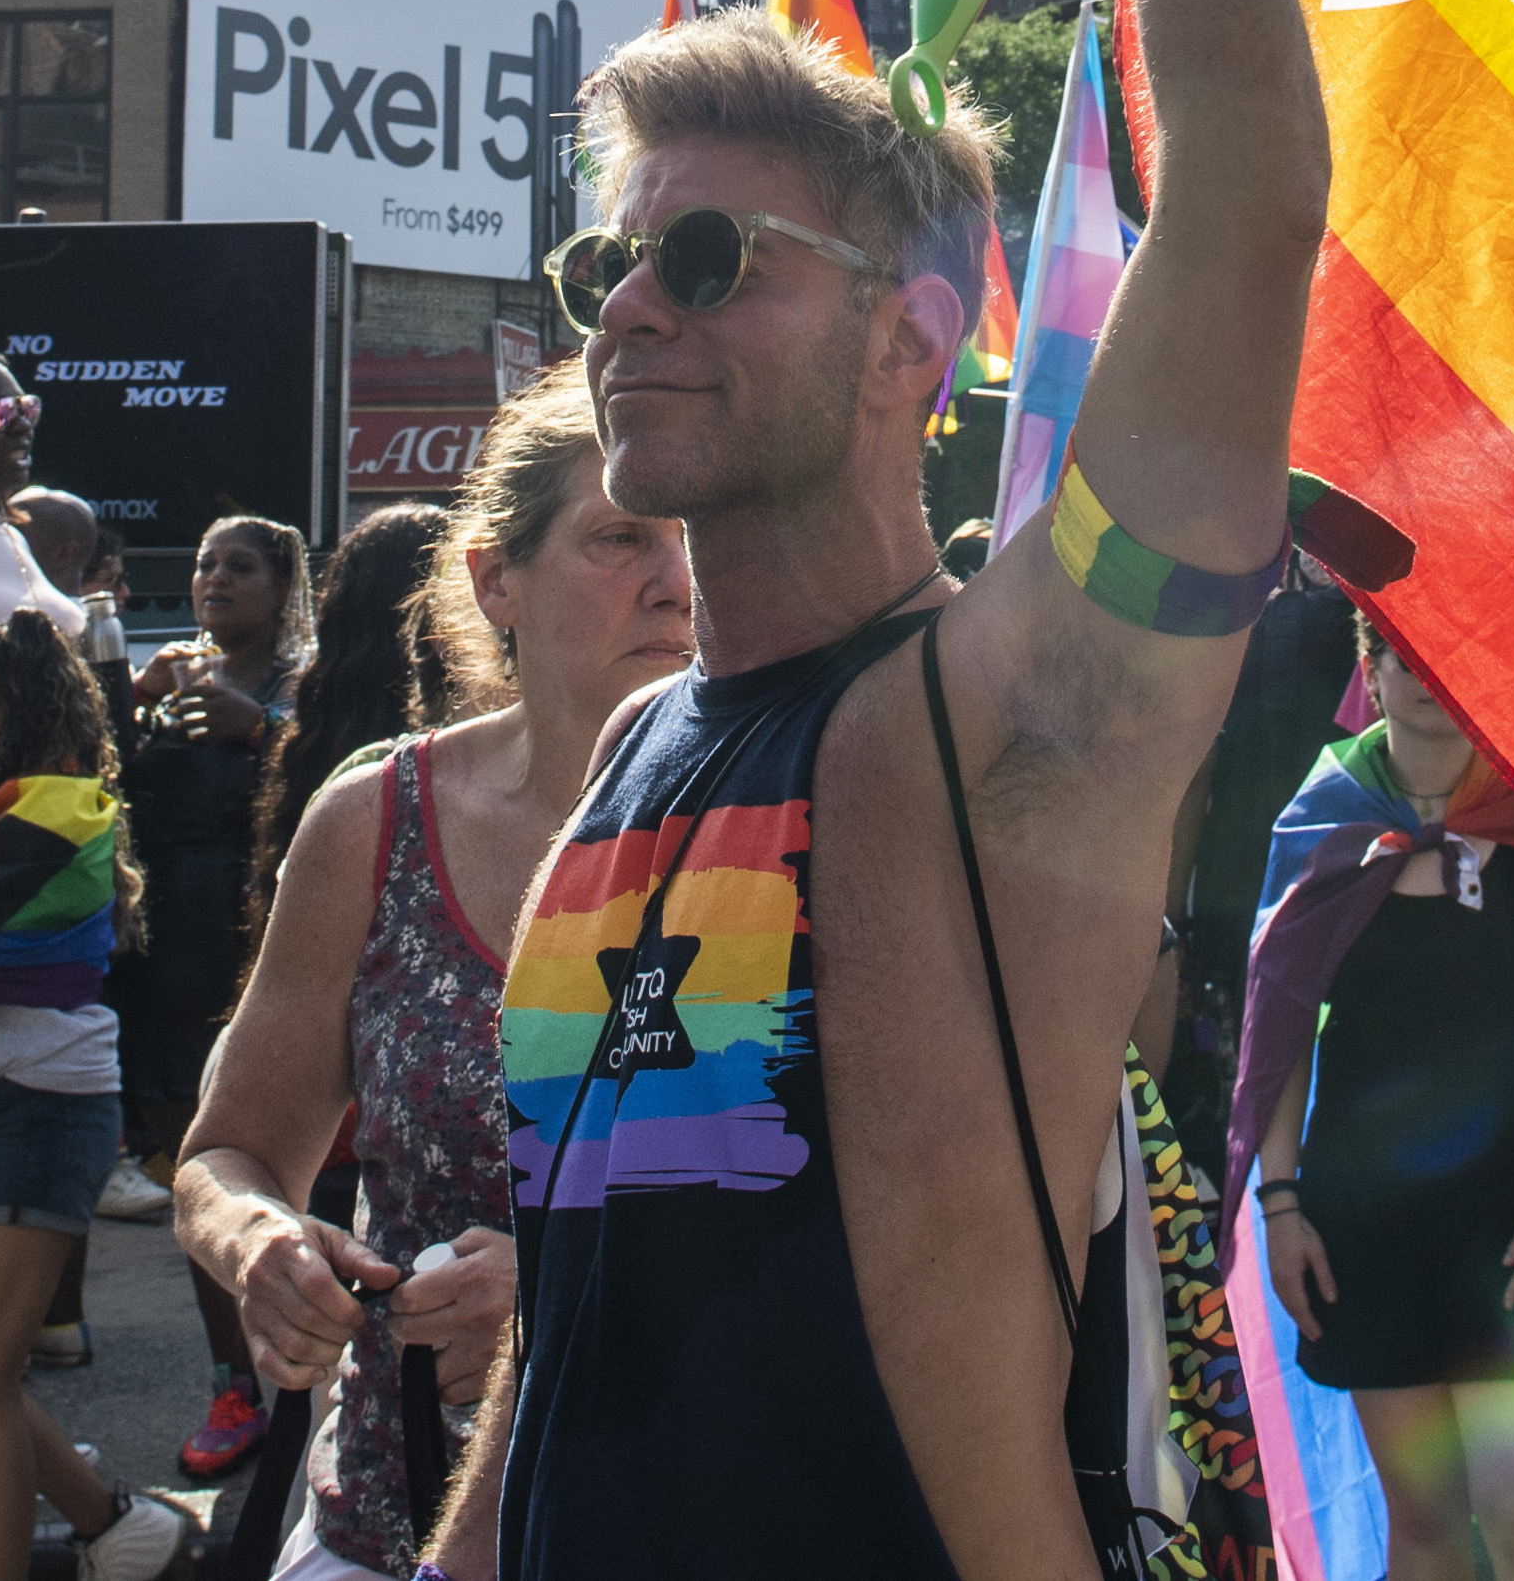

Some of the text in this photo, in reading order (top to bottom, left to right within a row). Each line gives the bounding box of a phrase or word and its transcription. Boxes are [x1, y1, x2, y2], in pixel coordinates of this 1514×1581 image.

[213, 5, 533, 181] Pixel 5
[382, 198, 504, 238] From $499
[5, 334, 54, 355] NO
[34, 360, 186, 382] SUDDEN
[122, 386, 228, 407] MOVE
